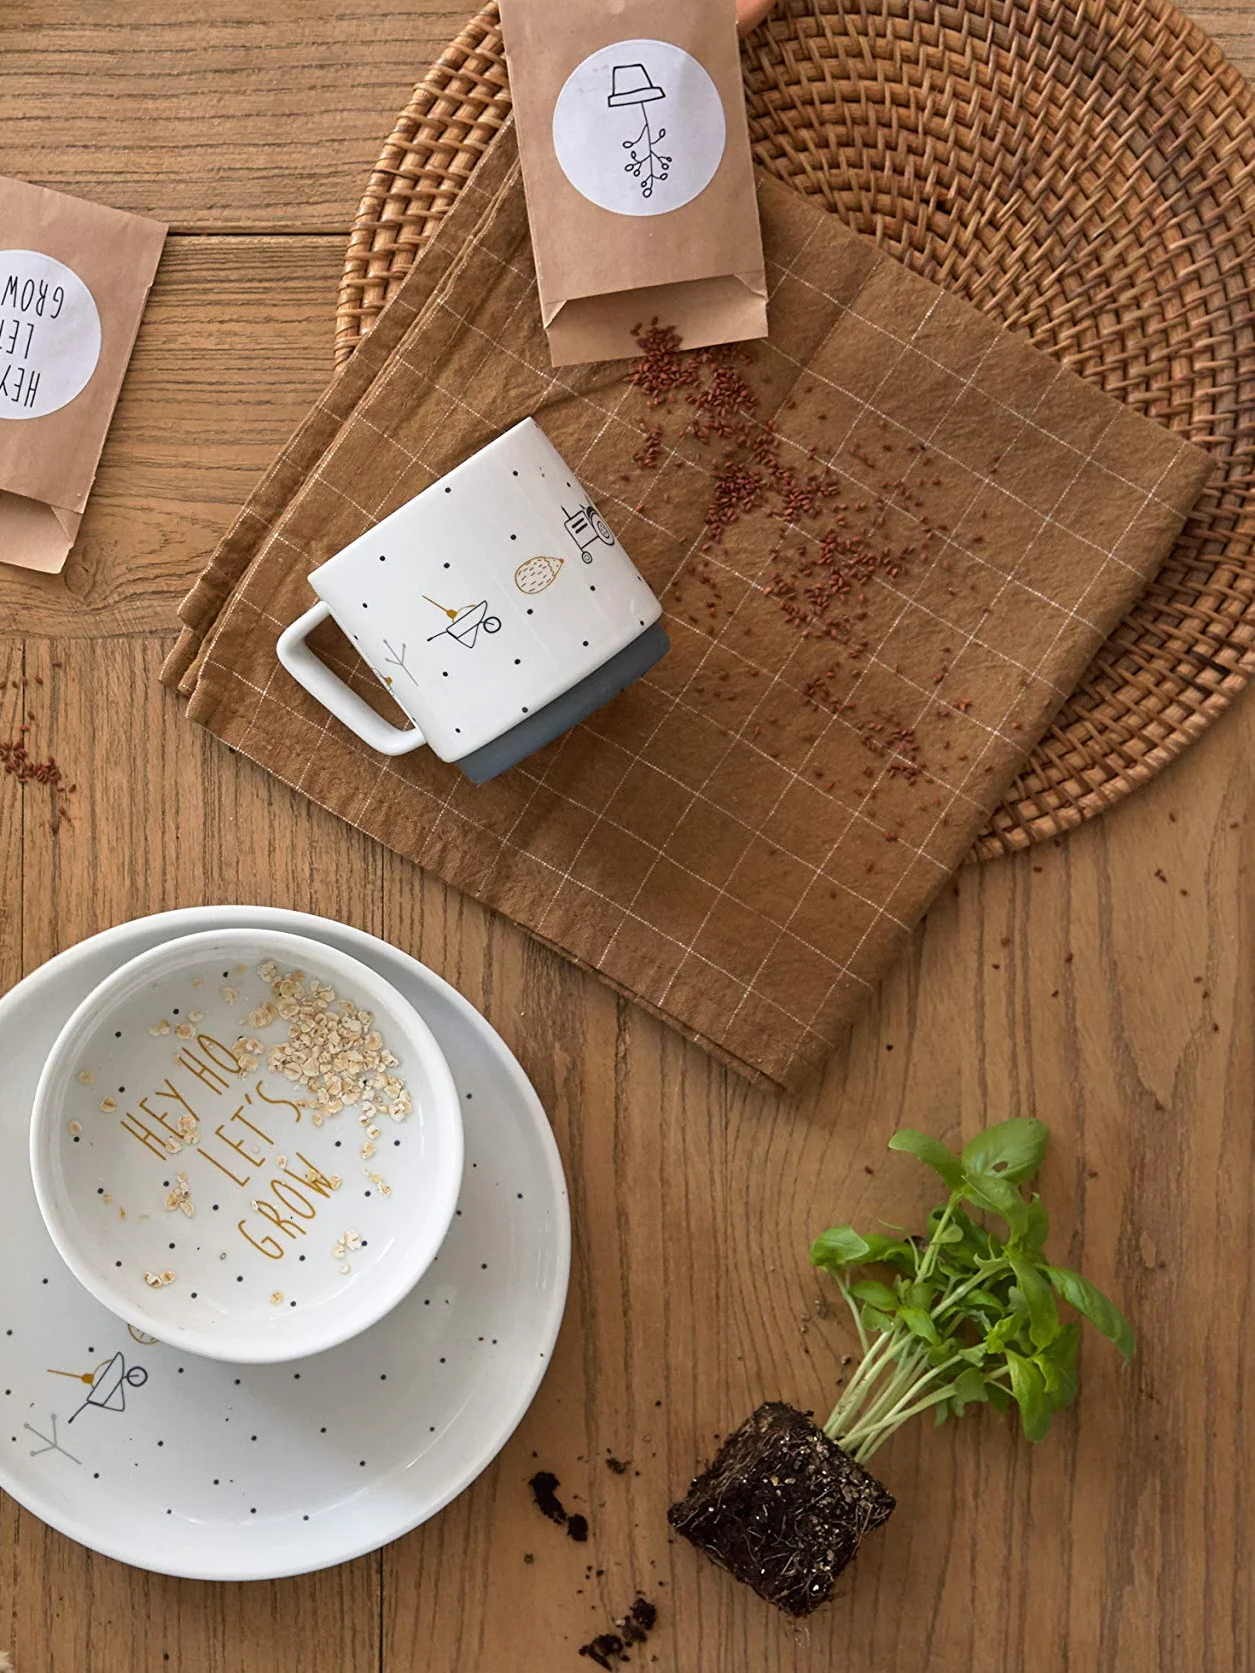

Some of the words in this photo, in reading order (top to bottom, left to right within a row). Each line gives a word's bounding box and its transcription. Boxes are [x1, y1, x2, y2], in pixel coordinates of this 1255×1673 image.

[0, 274, 65, 319] GROW
[120, 1078, 201, 1161] HEY
[177, 1034, 242, 1095] HO
[196, 1080, 301, 1187] LET'S
[238, 1152, 333, 1260] GROW
